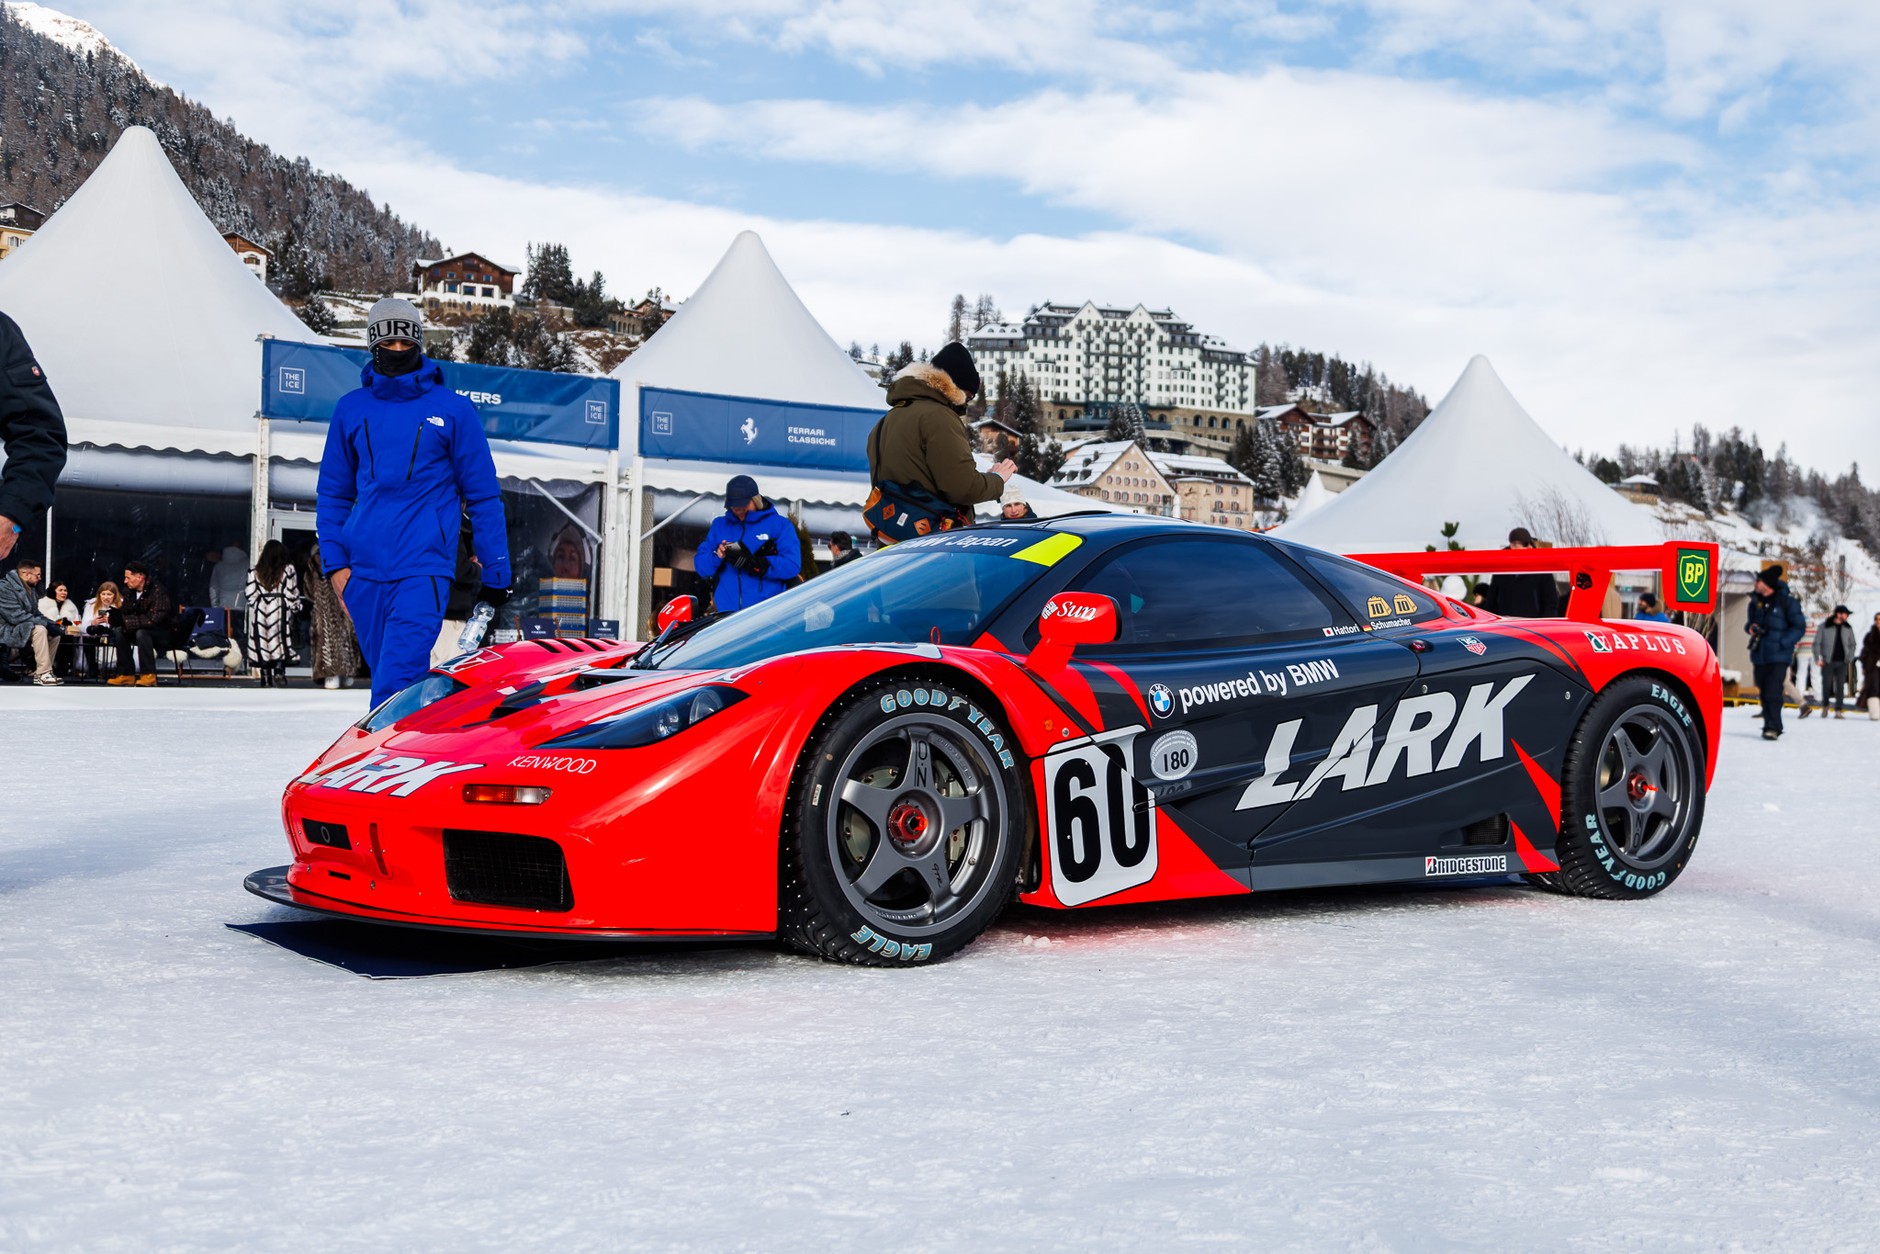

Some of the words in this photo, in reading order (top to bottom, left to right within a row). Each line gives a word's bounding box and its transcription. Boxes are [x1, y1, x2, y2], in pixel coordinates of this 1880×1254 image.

[369, 321, 422, 342] BURB
[285, 373, 299, 381] THE
[286, 381, 299, 389] ICE
[590, 412, 602, 420] ICE
[656, 416, 668, 424] THE
[788, 427, 824, 436] FERRARI
[788, 436, 836, 446] CLASSICHE
[946, 535, 1018, 549] Japan
[1685, 562, 1704, 584] BP
[1057, 600, 1097, 621] Sun
[1370, 603, 1384, 615] 10
[1396, 600, 1410, 612] 10
[1333, 624, 1360, 636] Hattori
[1370, 618, 1411, 631] Schumacher
[1614, 633, 1687, 656] APLUS
[1150, 684, 1169, 696] BMW
[1179, 672, 1261, 714] powered
[1259, 670, 1287, 696] by
[1286, 658, 1339, 686] BMW
[1651, 683, 1692, 727] EAGLE
[1235, 673, 1536, 811] LARK
[507, 755, 597, 774] KENWOOD
[1163, 749, 1189, 772] 180
[297, 751, 486, 798] LARK
[1054, 743, 1150, 883] 60
[1426, 857, 1505, 874] BRIDGESTONE
[851, 925, 933, 963] EAGLE
